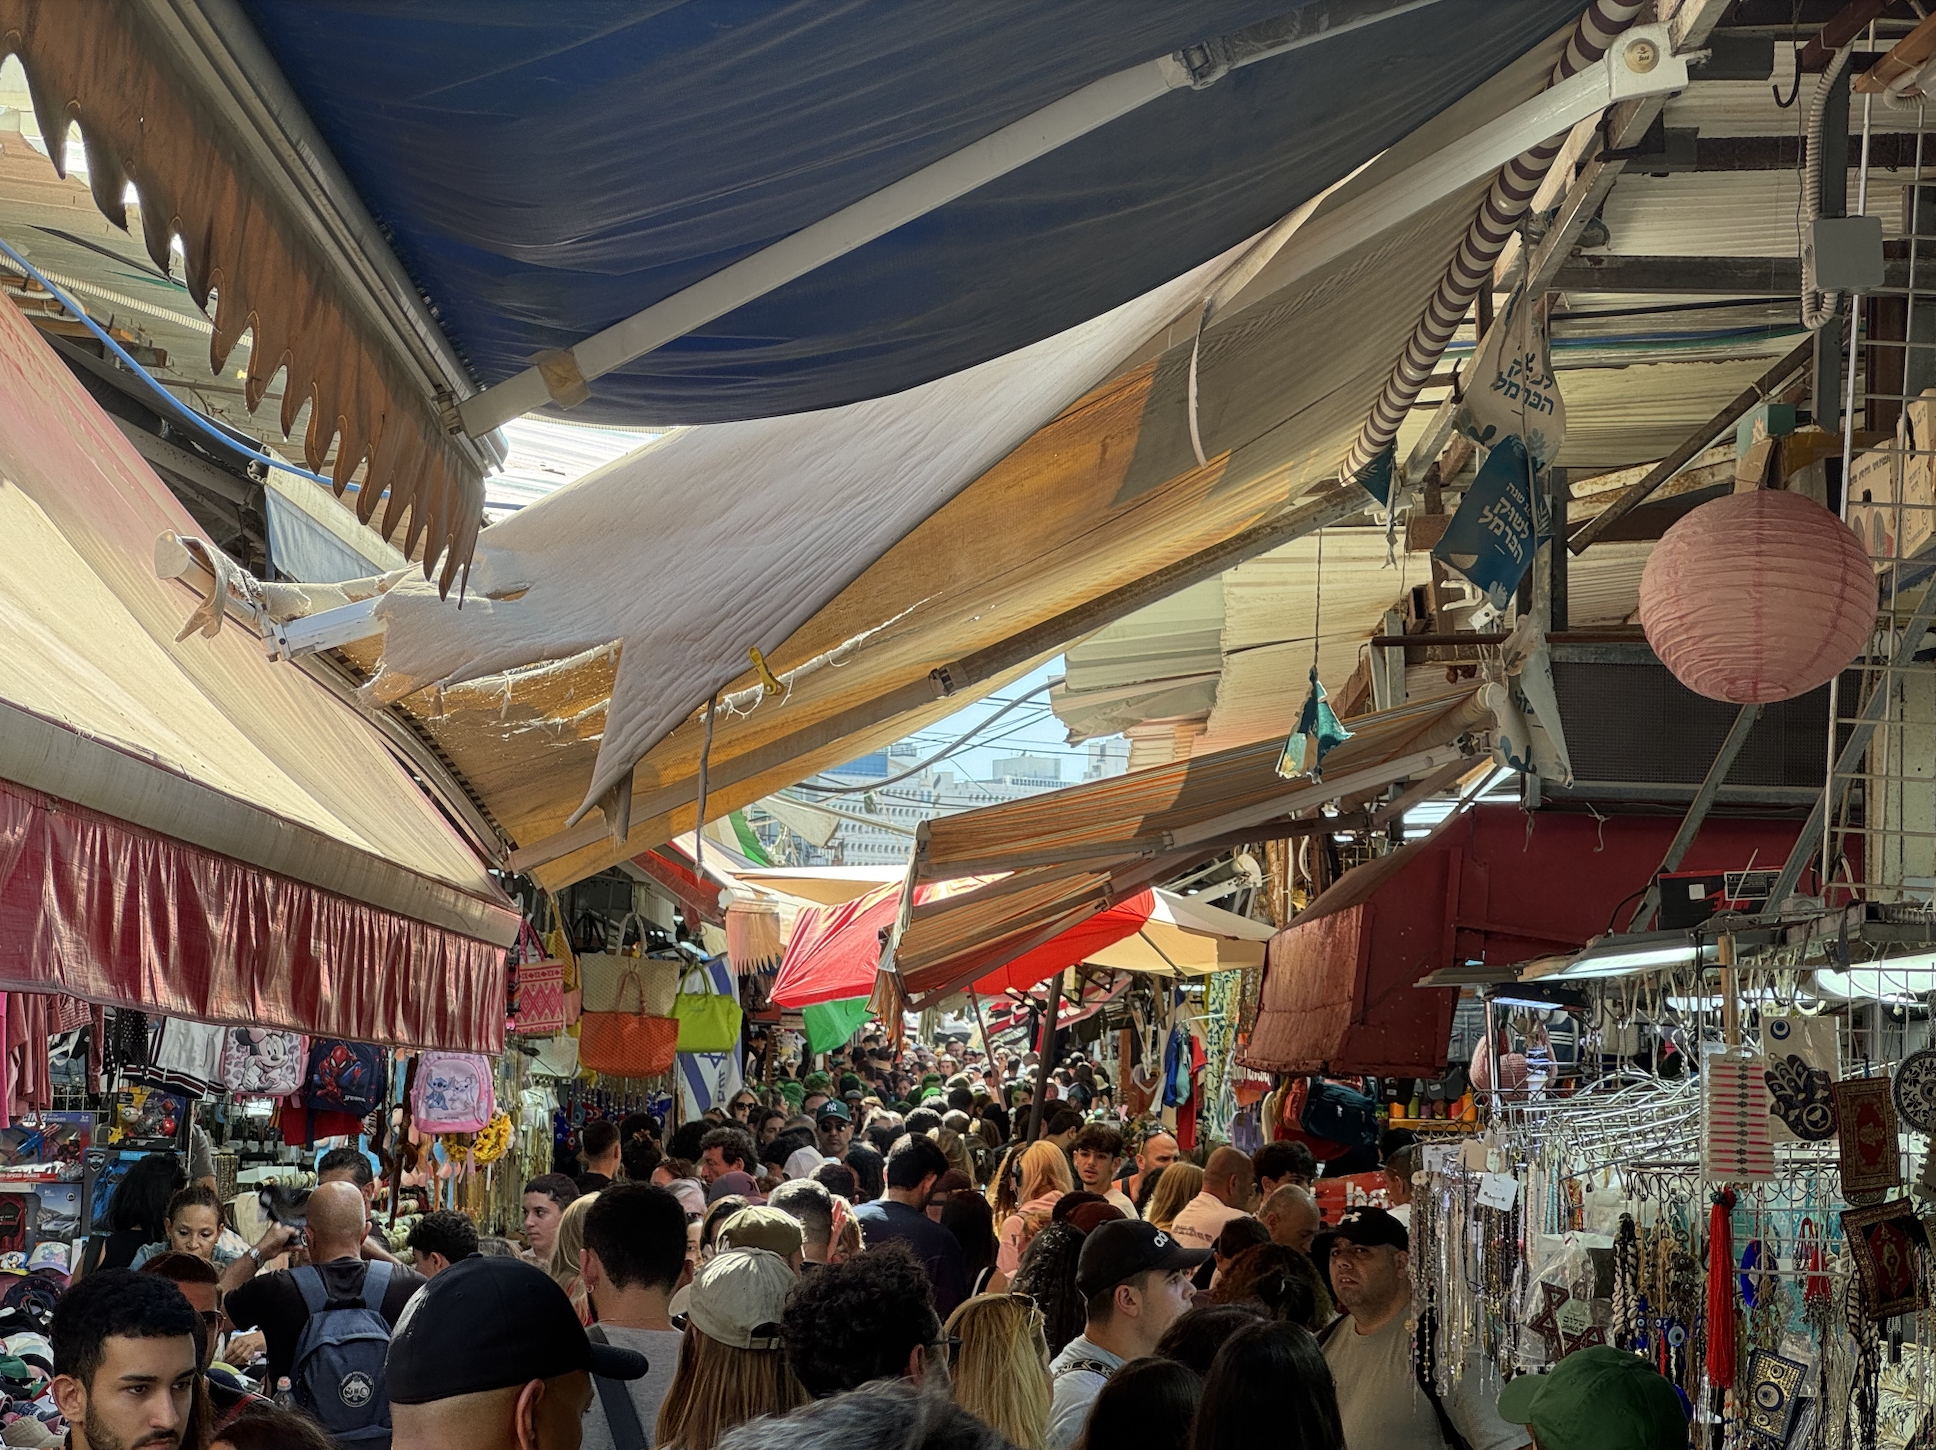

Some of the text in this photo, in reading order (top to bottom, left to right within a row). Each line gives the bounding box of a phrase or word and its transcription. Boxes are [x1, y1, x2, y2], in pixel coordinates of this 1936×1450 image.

[1494, 371, 1554, 415] הכרמל
[1505, 482, 1525, 504] שנה
[1478, 505, 1523, 564] הכרמל
[1493, 496, 1529, 539] לשוק
[1564, 1315, 1585, 1327] שלום
